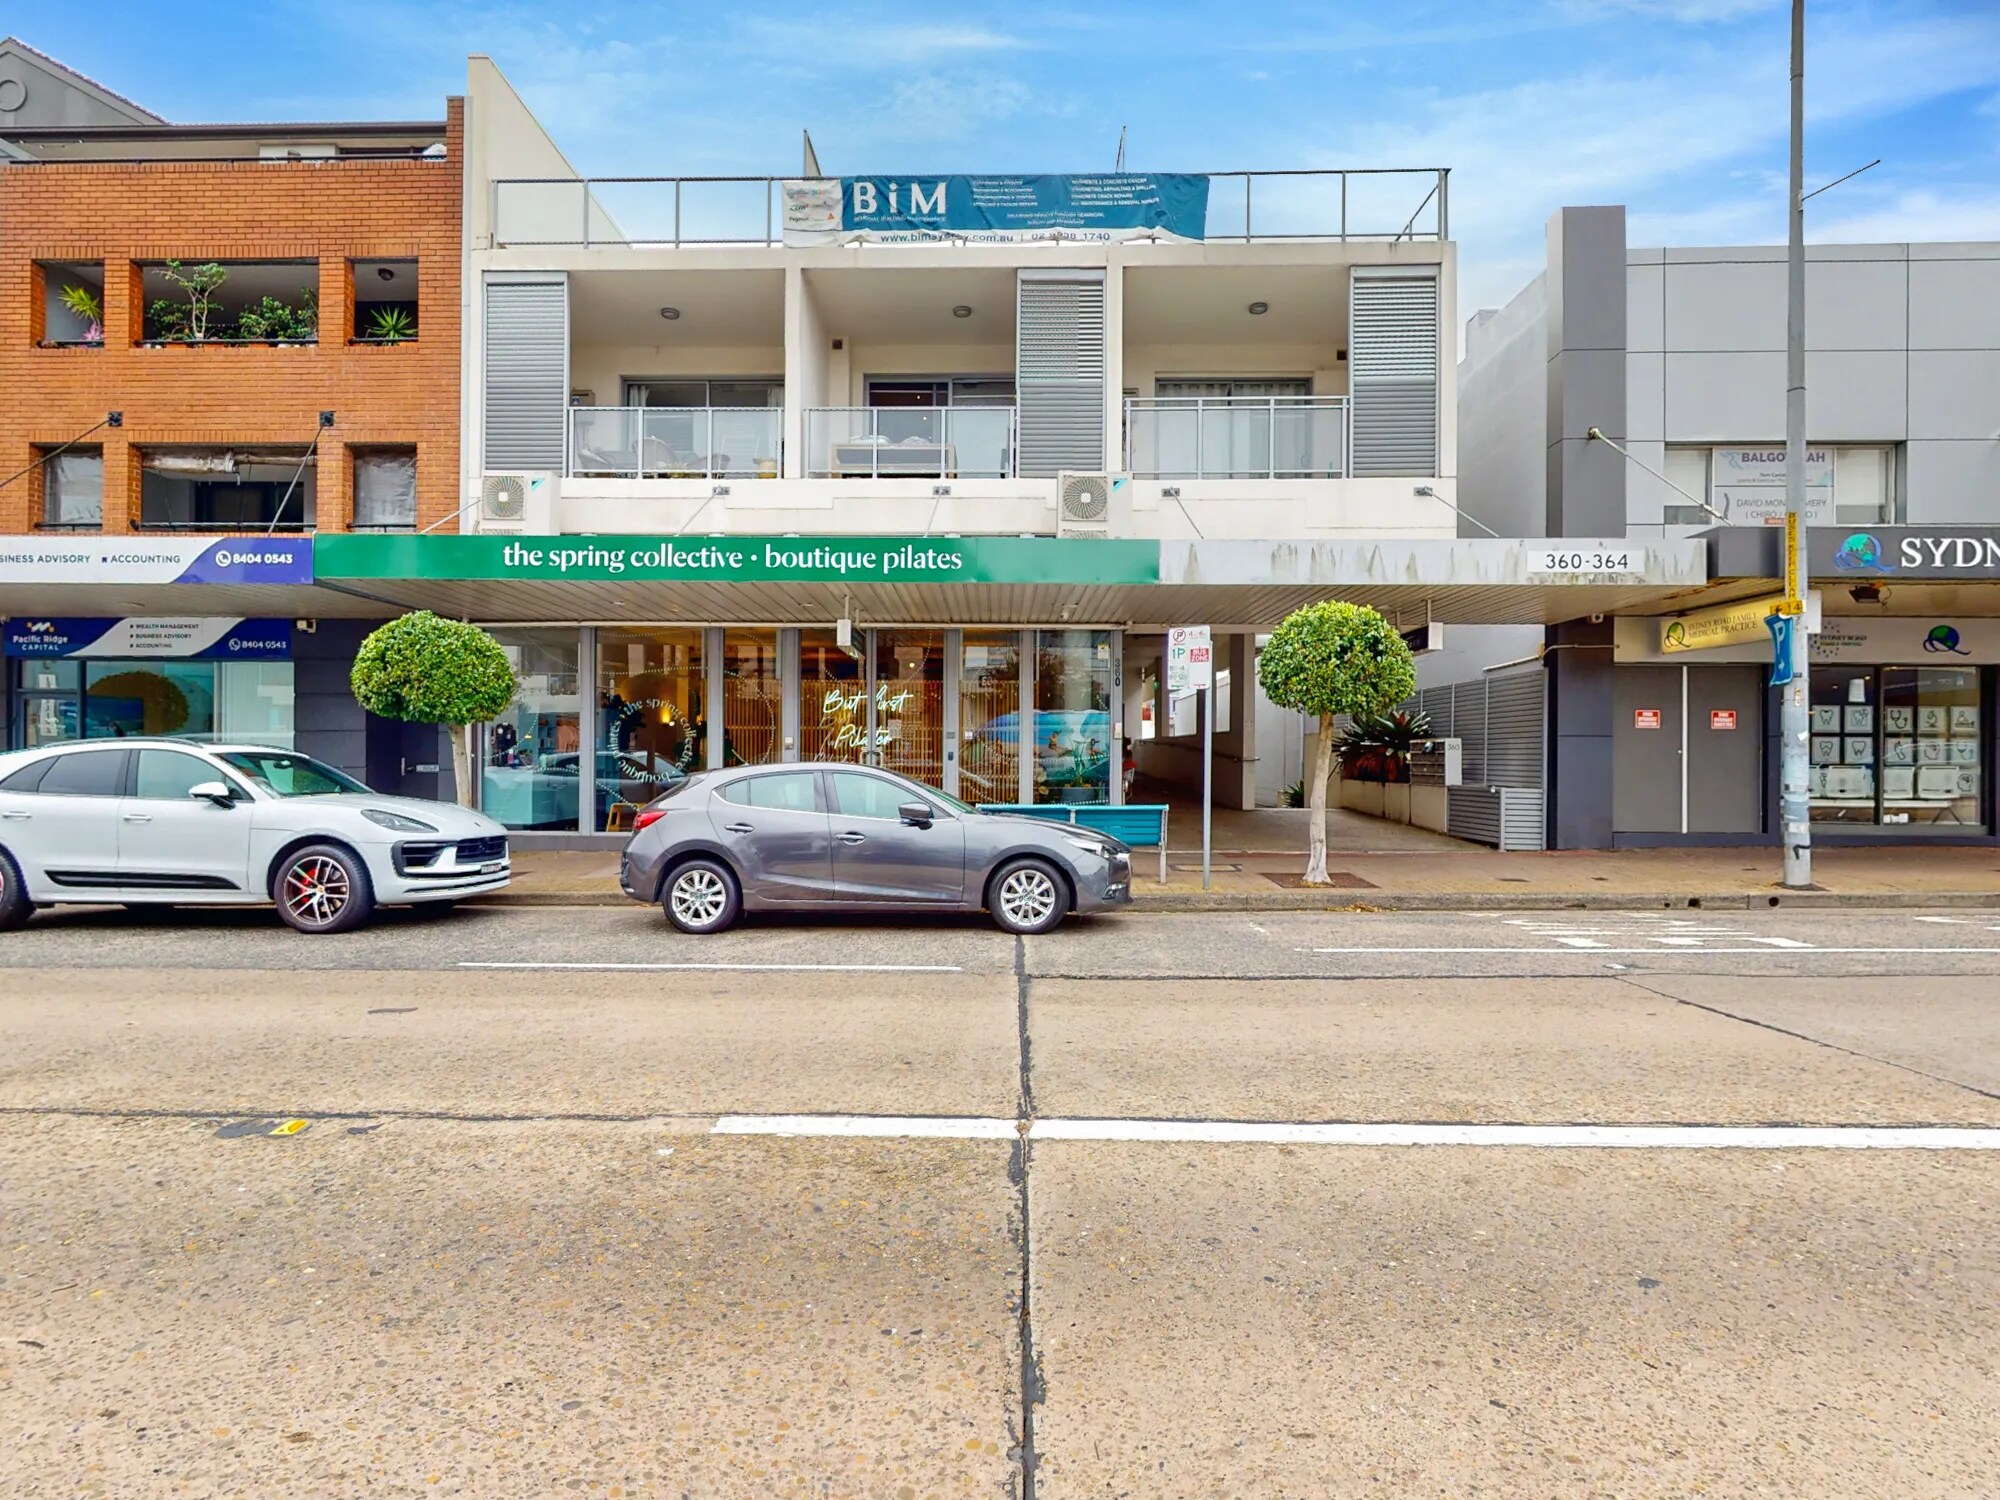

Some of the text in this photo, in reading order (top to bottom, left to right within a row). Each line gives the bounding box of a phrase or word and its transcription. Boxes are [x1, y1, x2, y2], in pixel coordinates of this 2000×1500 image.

[853, 181, 946, 214] BiM
[1083, 232, 1110, 241] 1740
[1741, 452, 1825, 462] BALGOAH
[1737, 499, 1763, 507] DAVID
[37, 555, 91, 563] ADVISORY
[110, 555, 181, 563] ACCOUNTING
[233, 553, 262, 564] 8404
[264, 553, 293, 564] 0543
[503, 542, 962, 574] the spring collective boutique pilates
[1545, 553, 1628, 569] 360-364
[1688, 620, 1712, 630] SYDNEY
[1713, 616, 1731, 626] ROAD
[1688, 621, 1758, 638] MEDICAL PRACTICE
[12, 635, 68, 644] Pacific Ridge
[242, 641, 287, 649] 8404 0543
[1172, 647, 1185, 660] 1P
[623, 700, 643, 715] the
[646, 698, 683, 720] spring
[823, 689, 868, 714] But
[674, 717, 697, 770] collective
[618, 760, 672, 783] boutique
